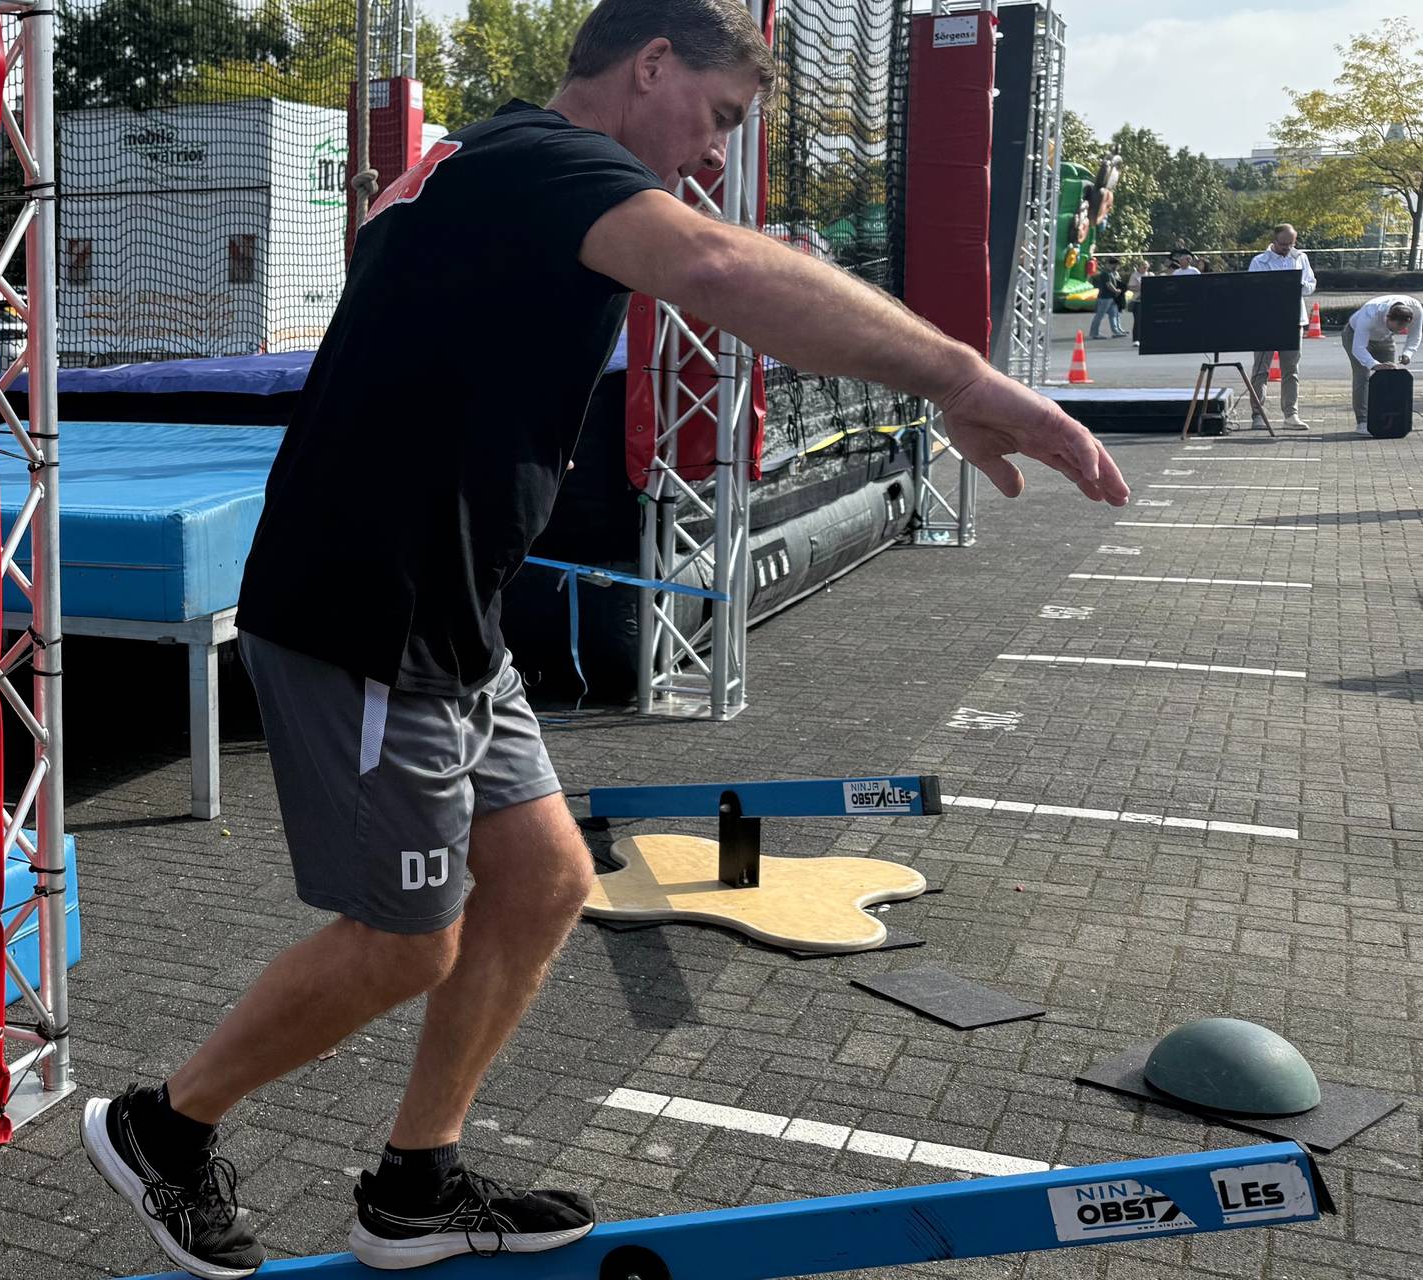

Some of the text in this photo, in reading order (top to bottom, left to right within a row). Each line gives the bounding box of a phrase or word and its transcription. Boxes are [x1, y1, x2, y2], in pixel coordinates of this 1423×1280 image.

[123, 129, 174, 146] mobile
[148, 147, 205, 164] warrior
[850, 782, 879, 792] NINJA
[851, 787, 912, 808] OBSTACLES
[401, 847, 449, 890] DJ
[1076, 1182, 1158, 1202] NINJ
